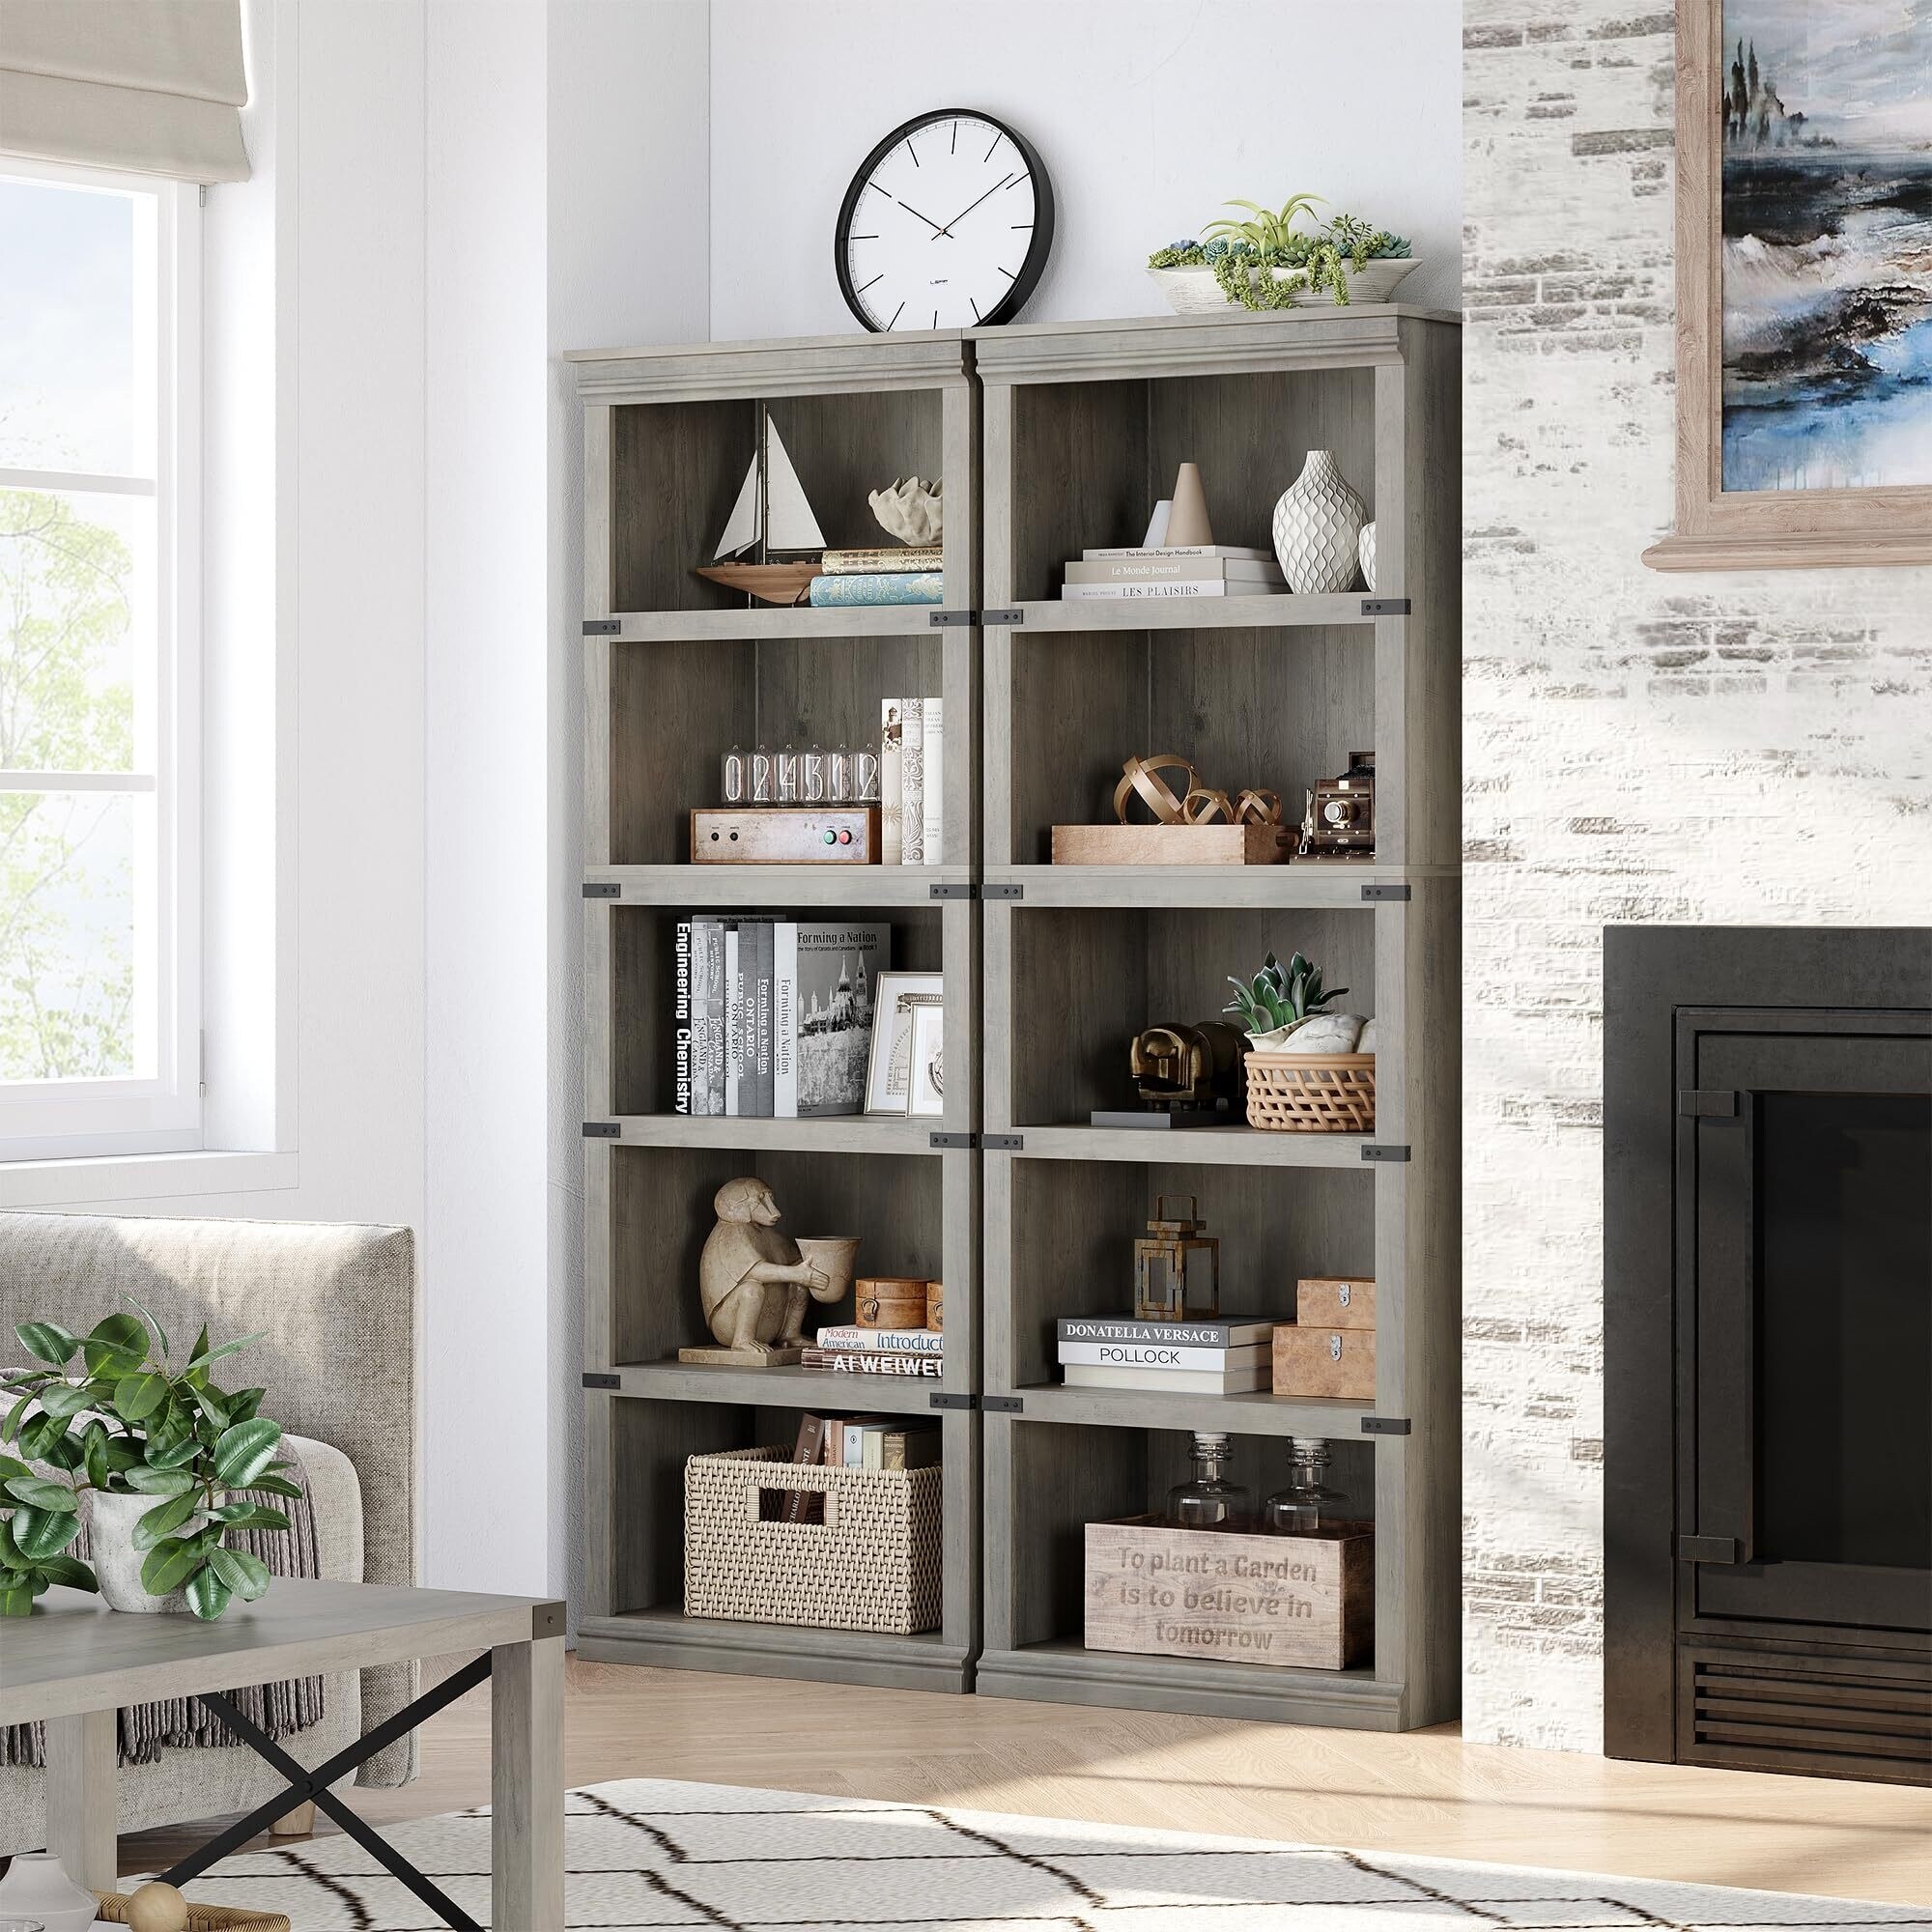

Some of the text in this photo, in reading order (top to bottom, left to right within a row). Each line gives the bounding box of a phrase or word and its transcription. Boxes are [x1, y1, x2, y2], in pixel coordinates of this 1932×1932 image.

[1112, 564, 1180, 576] Le Monde Journal
[1122, 585, 1199, 597] LES PLAISIRS
[797, 931, 877, 945] Forming a Nation
[711, 937, 722, 994] PUBLIC SCHOOL
[675, 923, 692, 1114] Engineering Chemistry
[760, 979, 770, 1027] Forming
[781, 979, 792, 1027] Forming
[694, 1017, 707, 1065] ENGLAND
[707, 1013, 724, 1065] ENGLAND
[746, 997, 755, 1058] ONTARIO
[760, 1037, 770, 1075] Nation
[781, 1038, 792, 1075] Nation
[822, 1338, 866, 1350] American
[825, 1328, 859, 1339] Modern
[1066, 1323, 1219, 1343] DONATELLA VERSACE
[1100, 1348, 1180, 1364] POLLOCK
[1118, 1546, 1317, 1582] To plant a Garden
[1120, 1581, 1313, 1619] is to believe in
[1155, 1619, 1273, 1651] tomorrow
